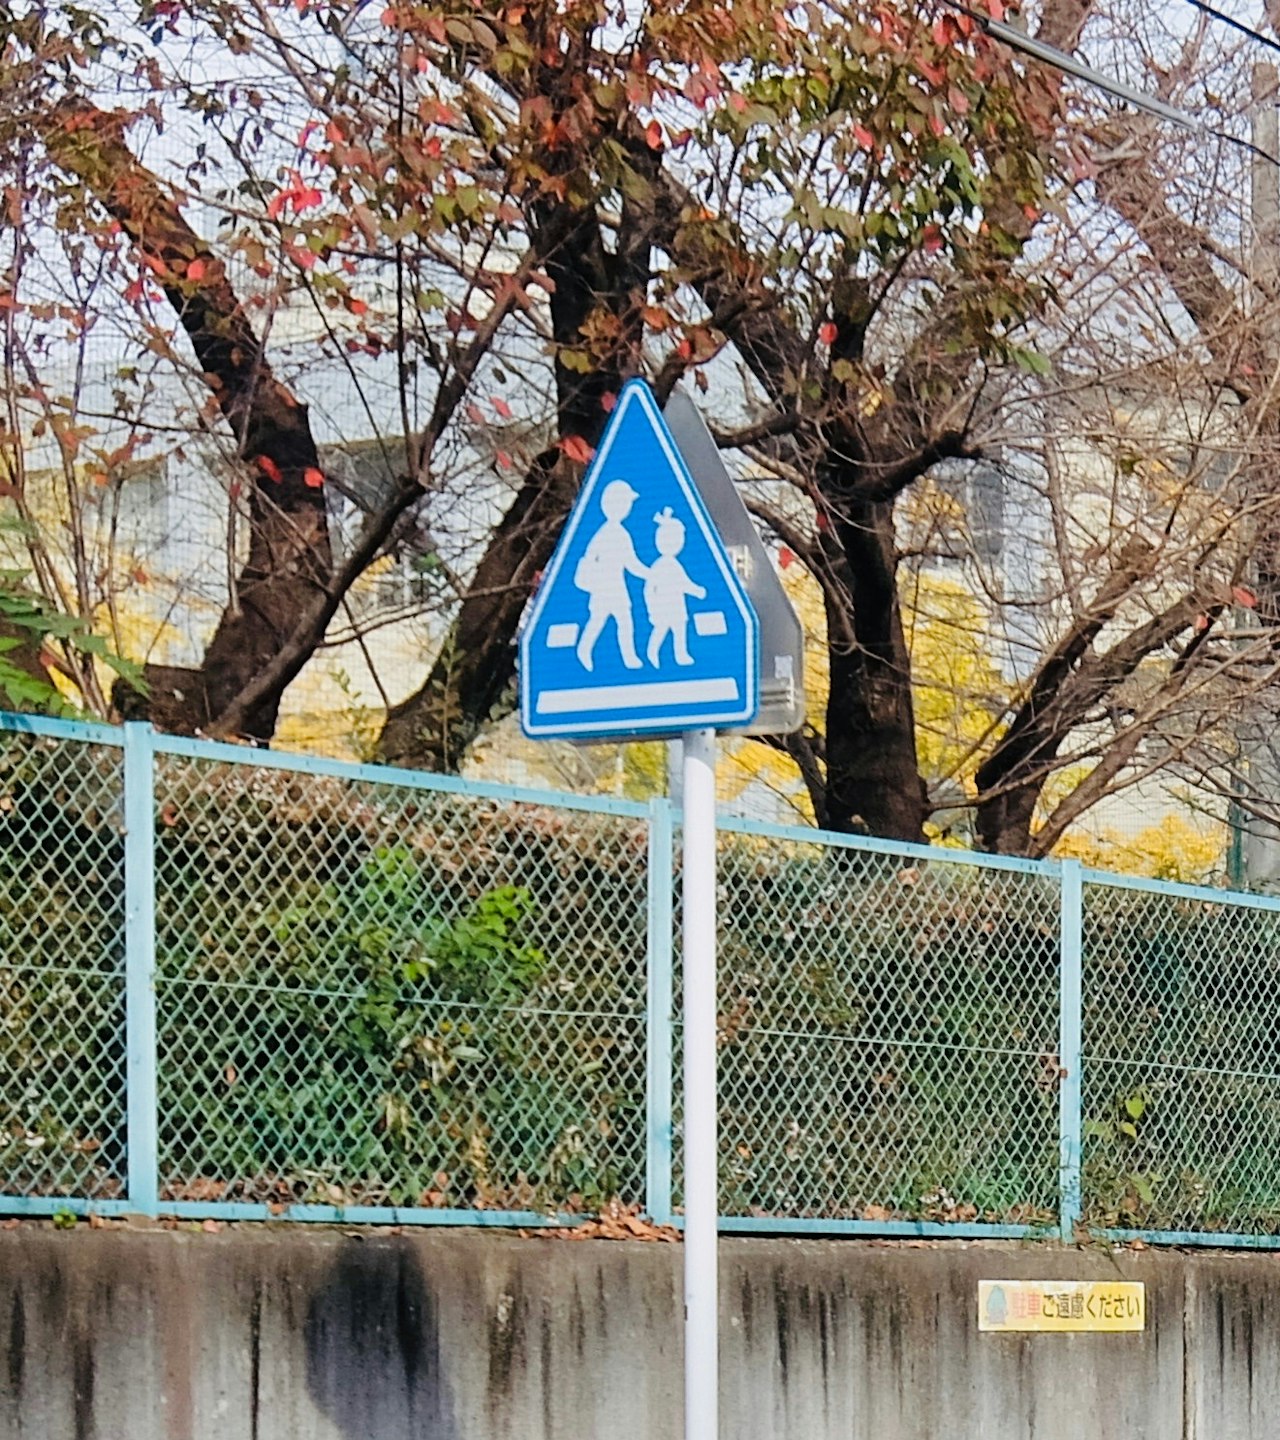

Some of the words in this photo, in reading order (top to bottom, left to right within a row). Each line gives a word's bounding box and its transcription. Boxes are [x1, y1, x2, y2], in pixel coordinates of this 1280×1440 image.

[1012, 1291, 1140, 1319] 駐車ご遠慮ください
